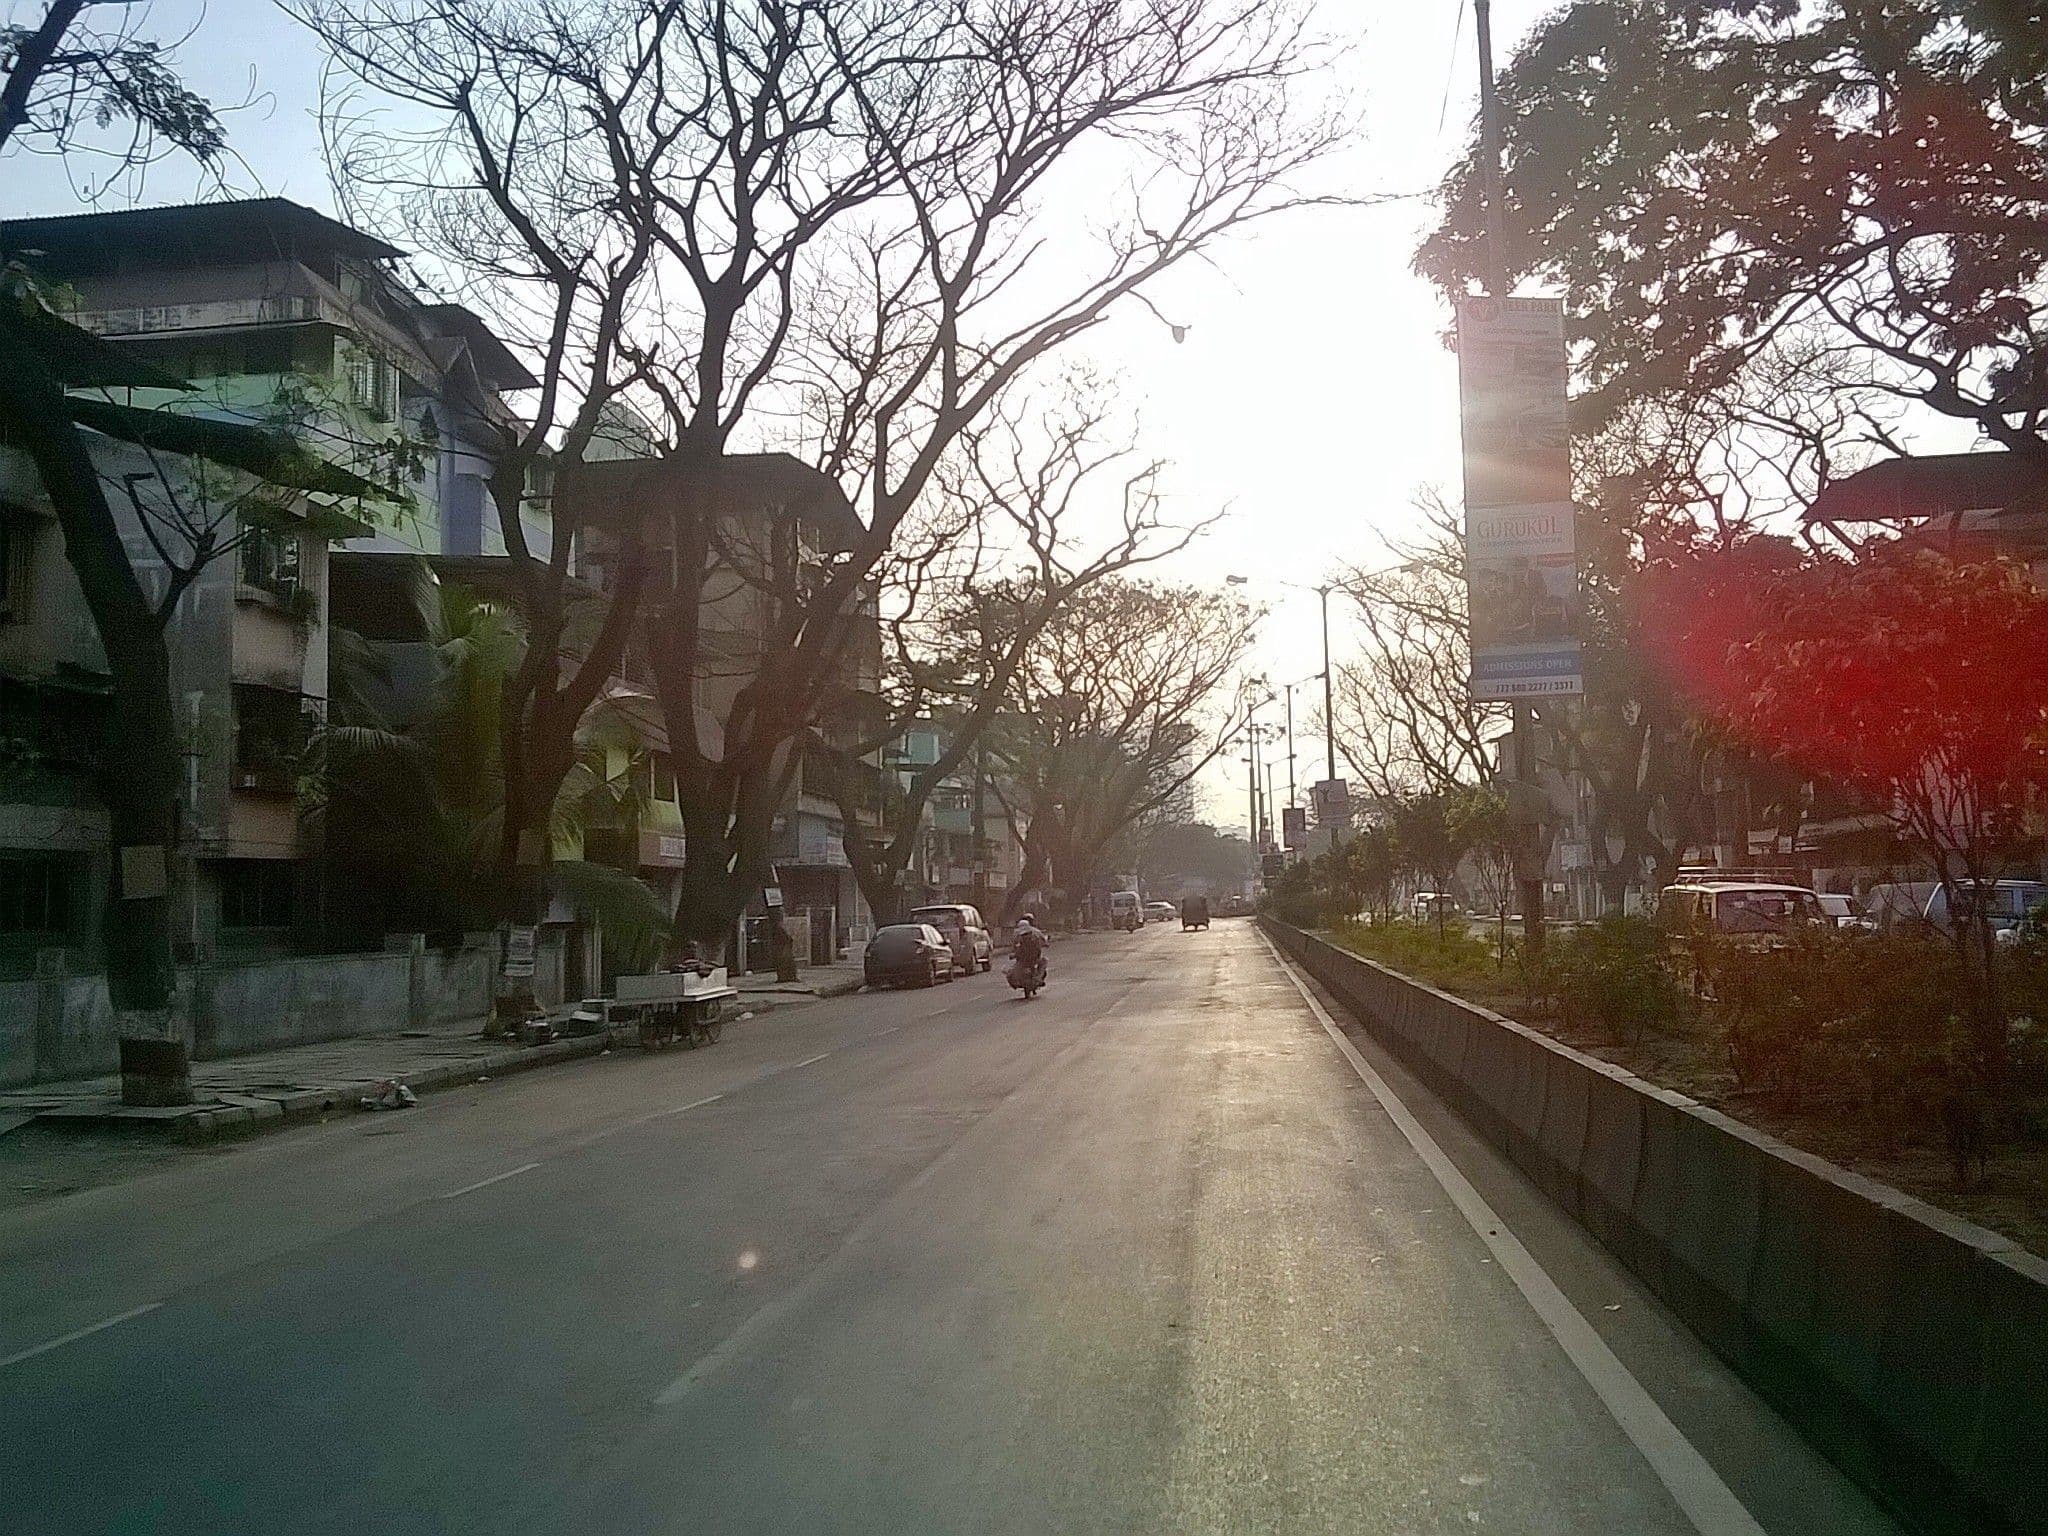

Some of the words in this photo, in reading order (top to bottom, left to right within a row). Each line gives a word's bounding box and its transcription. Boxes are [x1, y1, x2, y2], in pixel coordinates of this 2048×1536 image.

[1477, 515, 1563, 538] GURUKUL
[1483, 660, 1544, 672] ADMISSIONS
[1546, 659, 1572, 669] OPEN
